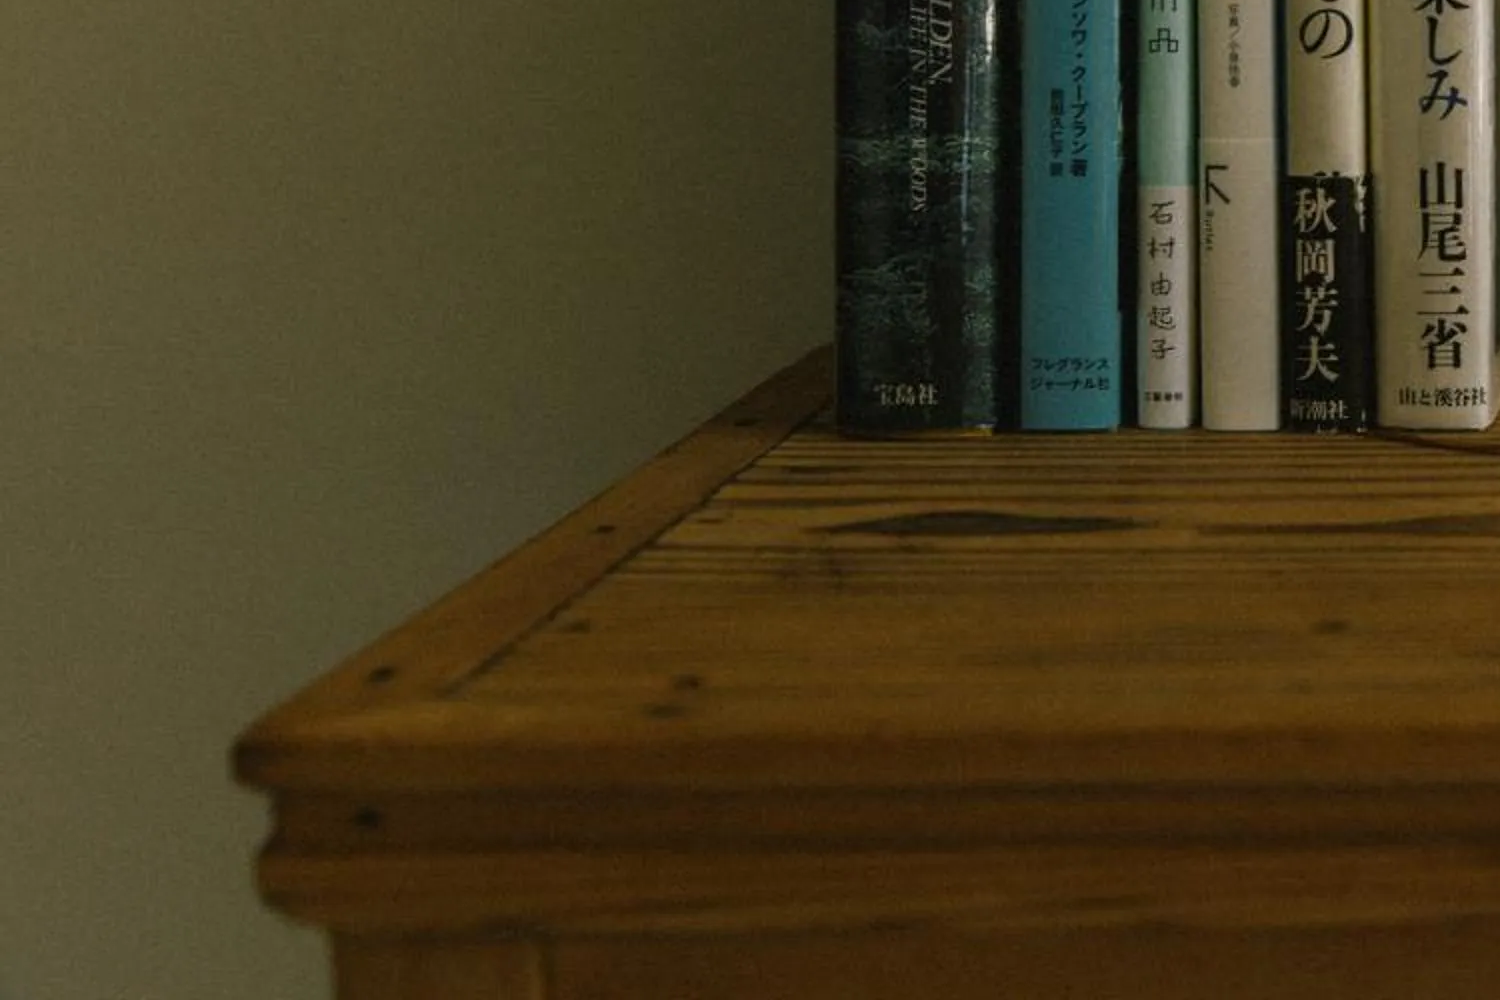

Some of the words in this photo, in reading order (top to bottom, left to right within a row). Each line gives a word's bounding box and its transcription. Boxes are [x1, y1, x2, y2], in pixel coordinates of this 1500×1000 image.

[910, 47, 927, 75] IN
[910, 84, 928, 130] THE
[1147, 201, 1177, 360] 石村由起子
[1293, 187, 1341, 382] 秋岡芳夫
[1416, 161, 1470, 370] 山尾三省
